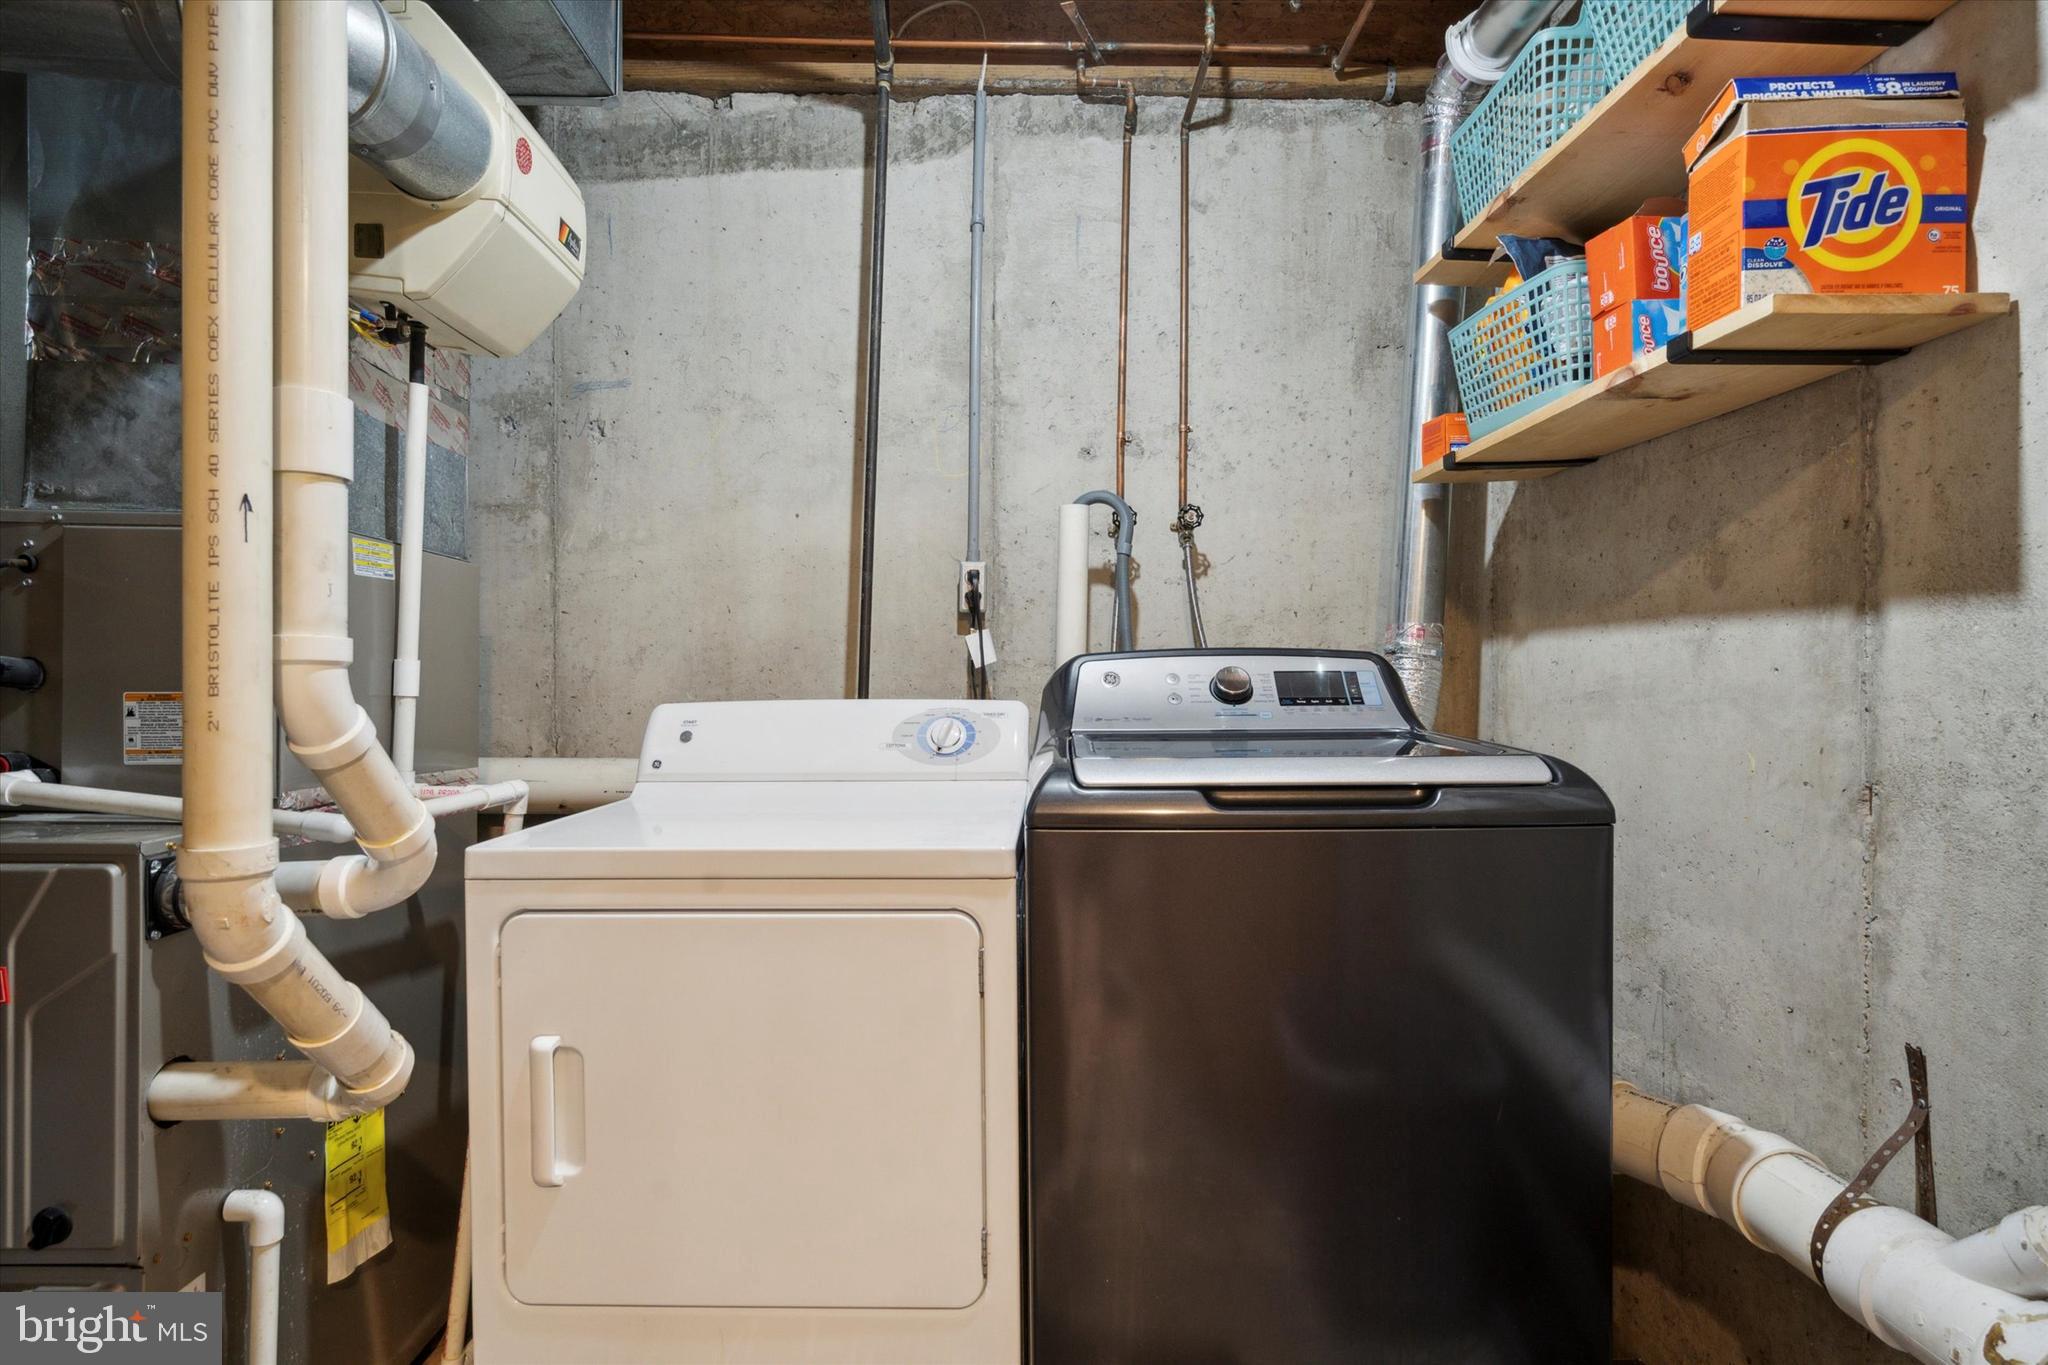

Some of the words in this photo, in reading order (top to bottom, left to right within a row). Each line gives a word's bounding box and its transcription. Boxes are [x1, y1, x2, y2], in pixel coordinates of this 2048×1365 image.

[207, 6, 219, 51] PIPE
[207, 62, 219, 98] DWV
[1769, 81, 1835, 91] PROTECTS
[1876, 81, 1904, 96] $8
[207, 109, 219, 144] PVC
[207, 154, 219, 201] CORE
[1800, 170, 1911, 251] Tide
[207, 212, 219, 305] CELLULAR
[1648, 226, 1670, 292] bounce
[1942, 285, 1959, 295] 75
[207, 315, 219, 362] COEX
[1640, 315, 1656, 356] ounce
[207, 373, 219, 443] SERIES
[207, 454, 219, 477] 40
[207, 488, 219, 524] SCH
[207, 535, 219, 567] IPS
[207, 581, 219, 698] BRISTOLITE
